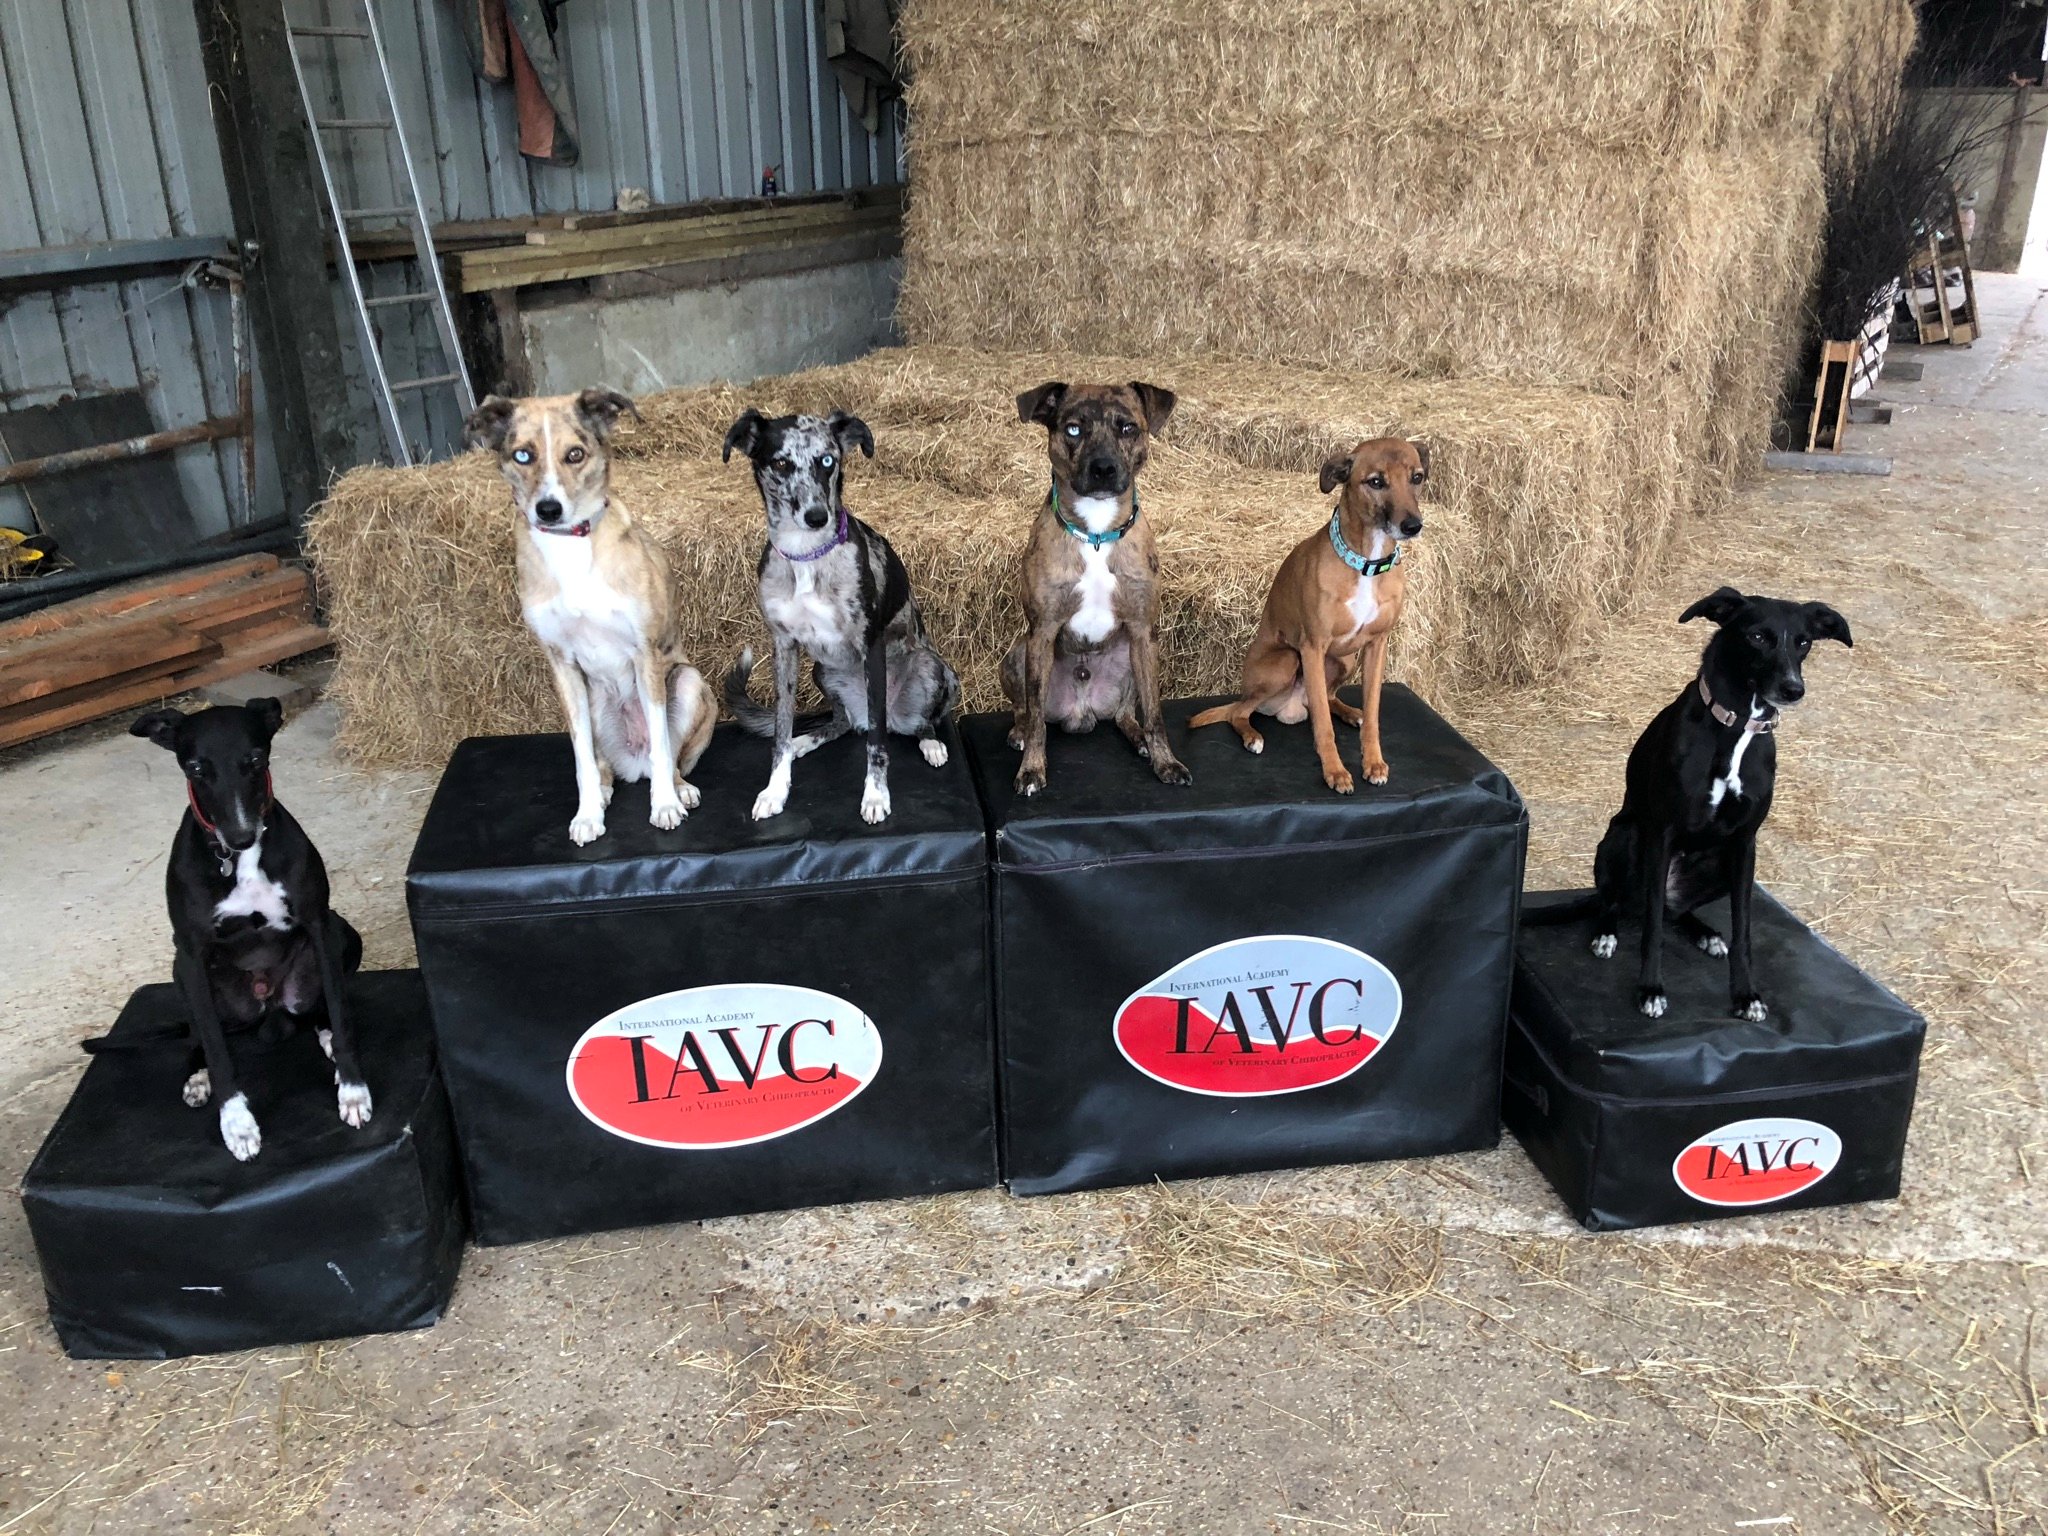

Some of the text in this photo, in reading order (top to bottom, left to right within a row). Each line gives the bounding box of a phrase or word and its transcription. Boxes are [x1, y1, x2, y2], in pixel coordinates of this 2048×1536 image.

[705, 1011, 756, 1024] ACADEMY
[1166, 977, 1363, 1054] IAVC
[619, 1018, 839, 1105] IAVC
[1702, 1136, 1820, 1181] IAVC
